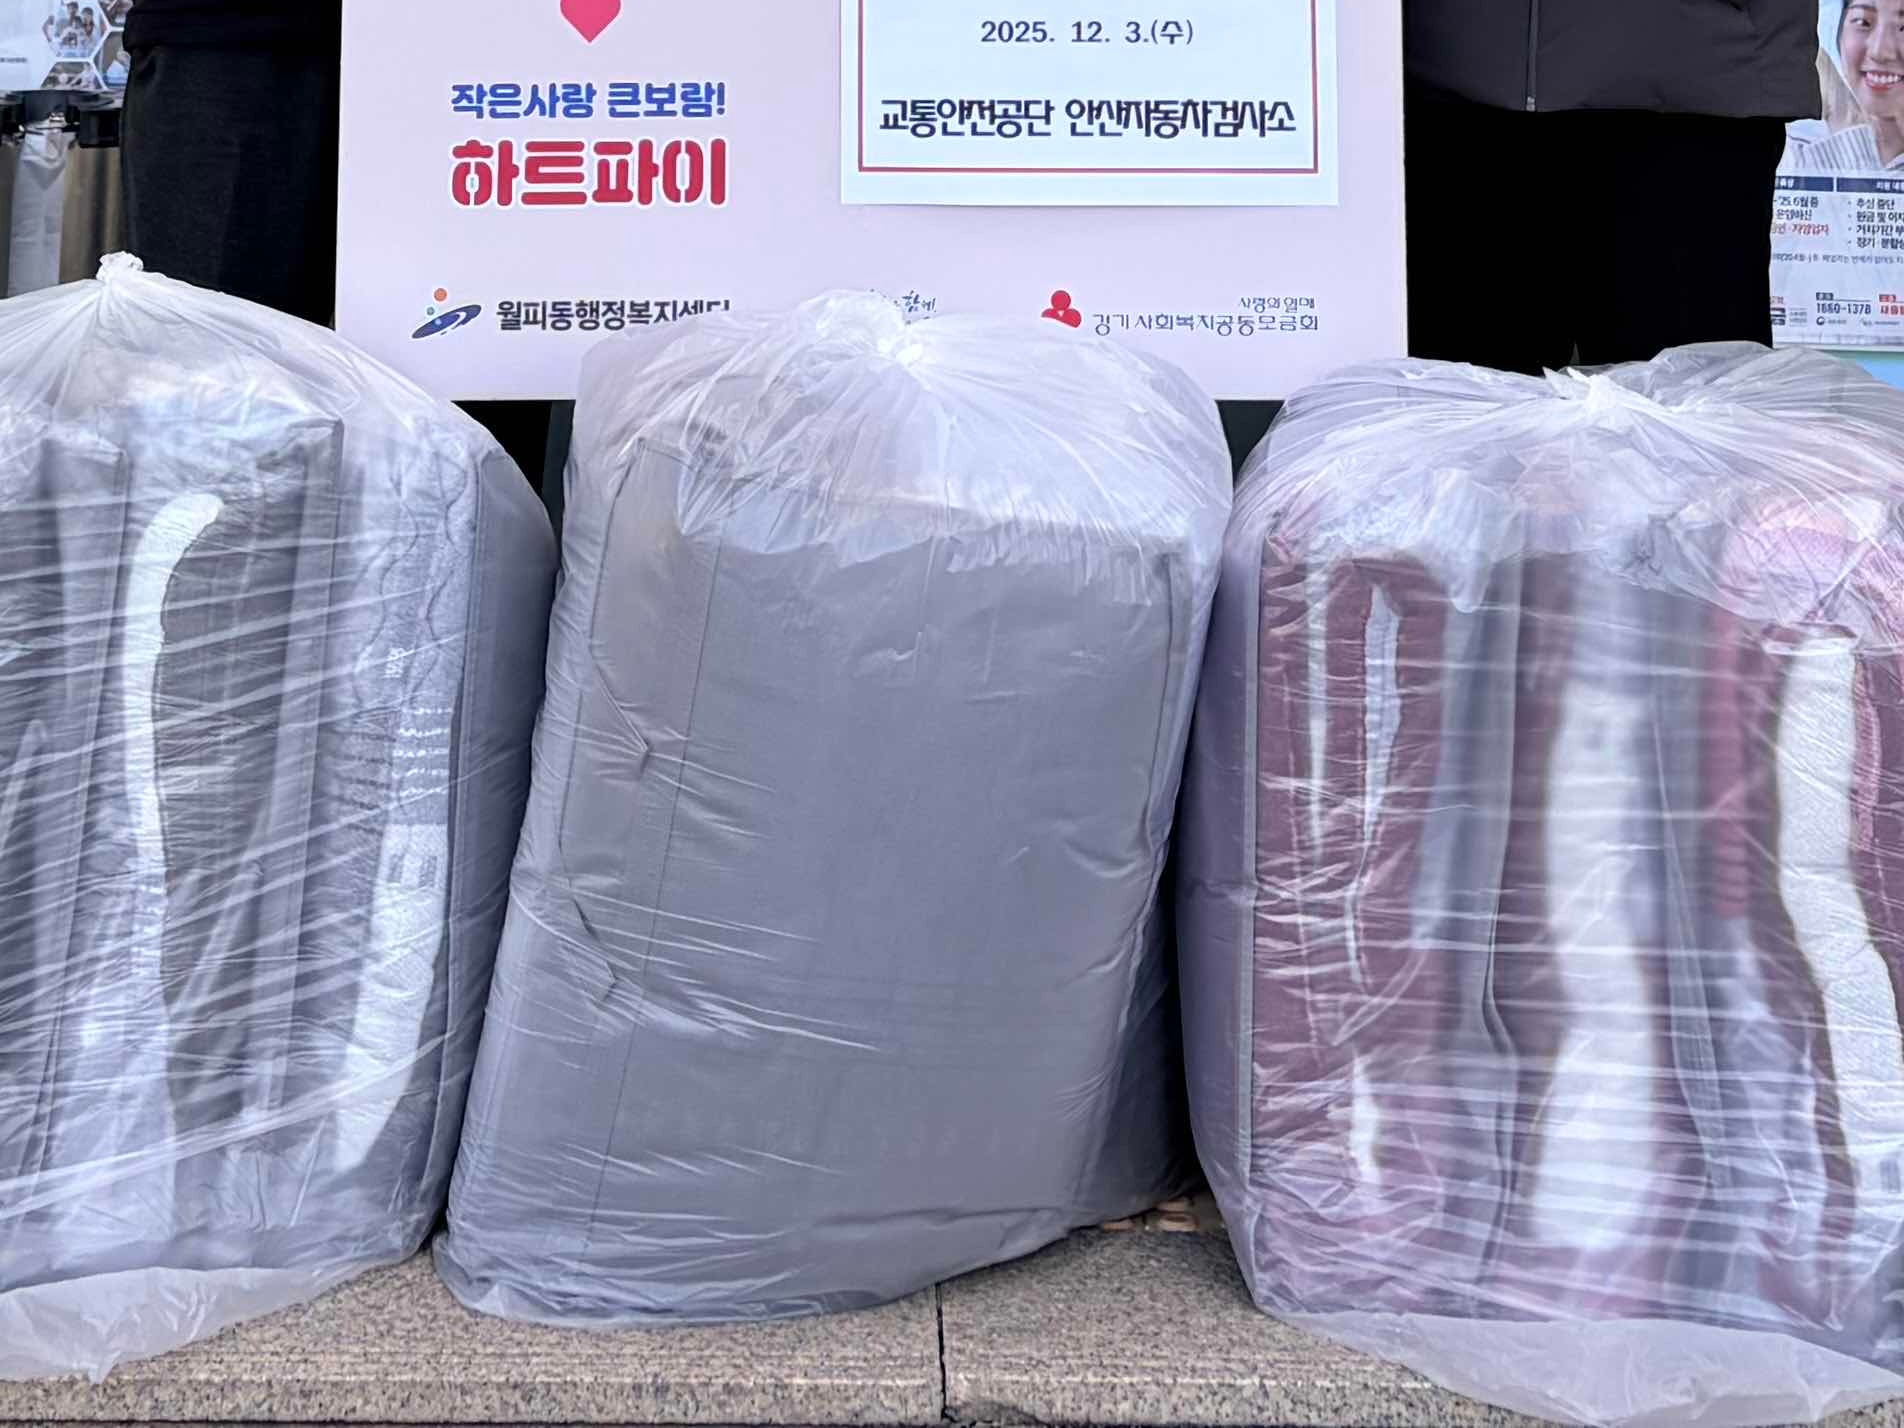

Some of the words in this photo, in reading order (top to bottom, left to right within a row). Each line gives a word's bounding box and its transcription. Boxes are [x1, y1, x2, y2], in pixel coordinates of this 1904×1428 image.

[980, 20, 1056, 44] 2025.
[1070, 20, 1111, 44] 12.
[1124, 18, 1194, 45] 3.(수)
[451, 82, 597, 119] 작은사랑
[606, 81, 726, 118] 큰보람!
[879, 98, 1055, 139] 교통안전공단
[1064, 98, 1297, 140] 안산자동차검사소
[451, 138, 727, 207] 하트파이
[1133, 313, 1319, 337] 사회복지공동모금회
